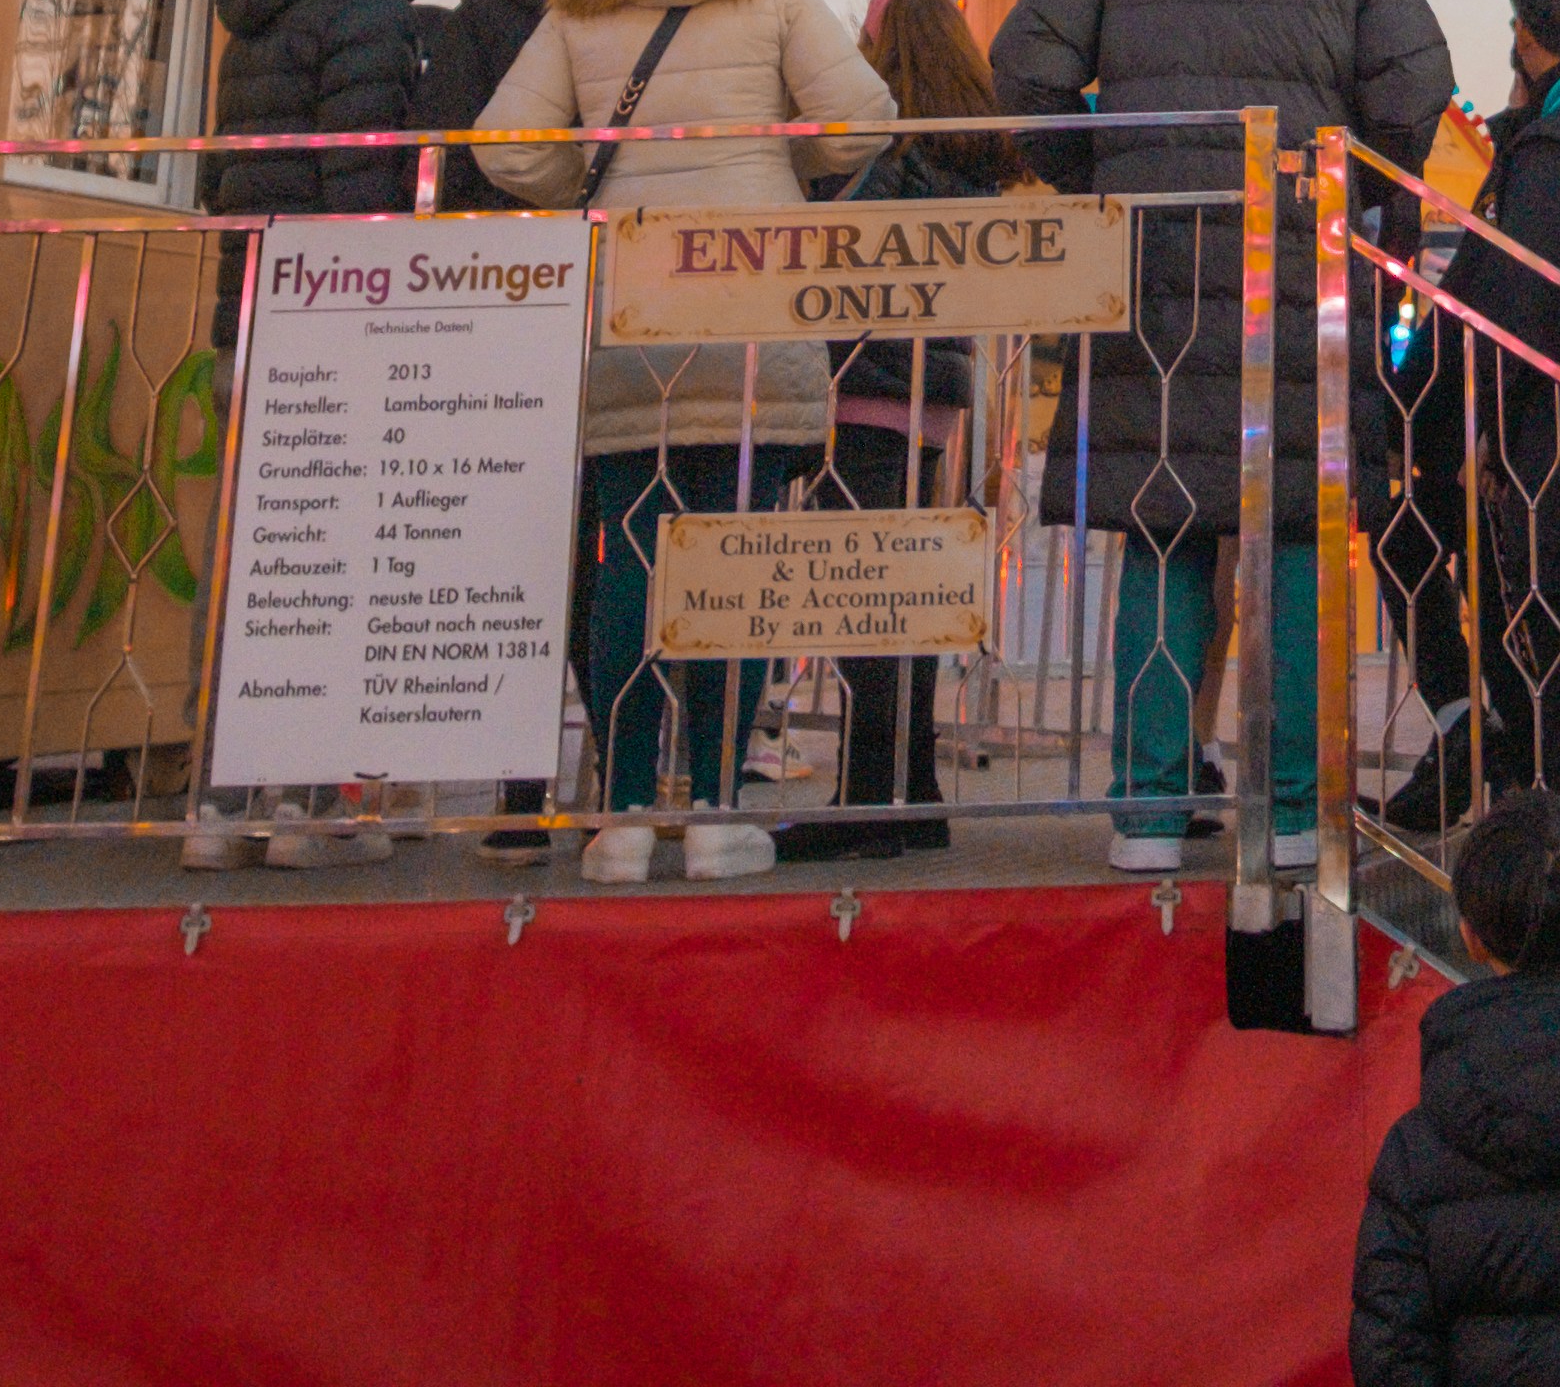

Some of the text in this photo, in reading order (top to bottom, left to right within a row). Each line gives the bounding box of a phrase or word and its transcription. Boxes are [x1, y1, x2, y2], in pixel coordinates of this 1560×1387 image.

[674, 218, 1067, 275] ENTRANCE
[272, 252, 574, 307] Flying Swinger
[794, 282, 947, 323] ONLY
[365, 321, 473, 334] (Technische Daten)
[268, 364, 431, 387] Baujahr: 2013
[265, 392, 543, 416] Hersteller: Lamborghini Italien
[262, 427, 405, 451] Sitzplätze: 40
[259, 458, 525, 479] Grundfläche: 19.10 x 16 Meter
[257, 489, 468, 515] Transport: 1 Auflieger
[253, 523, 461, 544] Gewicht: 44 Tonnen
[720, 531, 942, 556] Children 6 Years
[250, 556, 415, 578] Aufbauzeit: 1 Tag
[772, 559, 889, 582] & Under
[247, 585, 525, 612] Beleuchtung: neuste LED Technik
[685, 584, 975, 613] Must Be Accompanied
[245, 614, 543, 637] Sicherheit: Gebaut nach neuster
[748, 610, 906, 643] By an Adult
[365, 641, 550, 662] DIN EN NORM 13814
[238, 674, 504, 698] Abnahme: TÜV Rheinland /
[360, 704, 482, 724] Kaiserslautern
